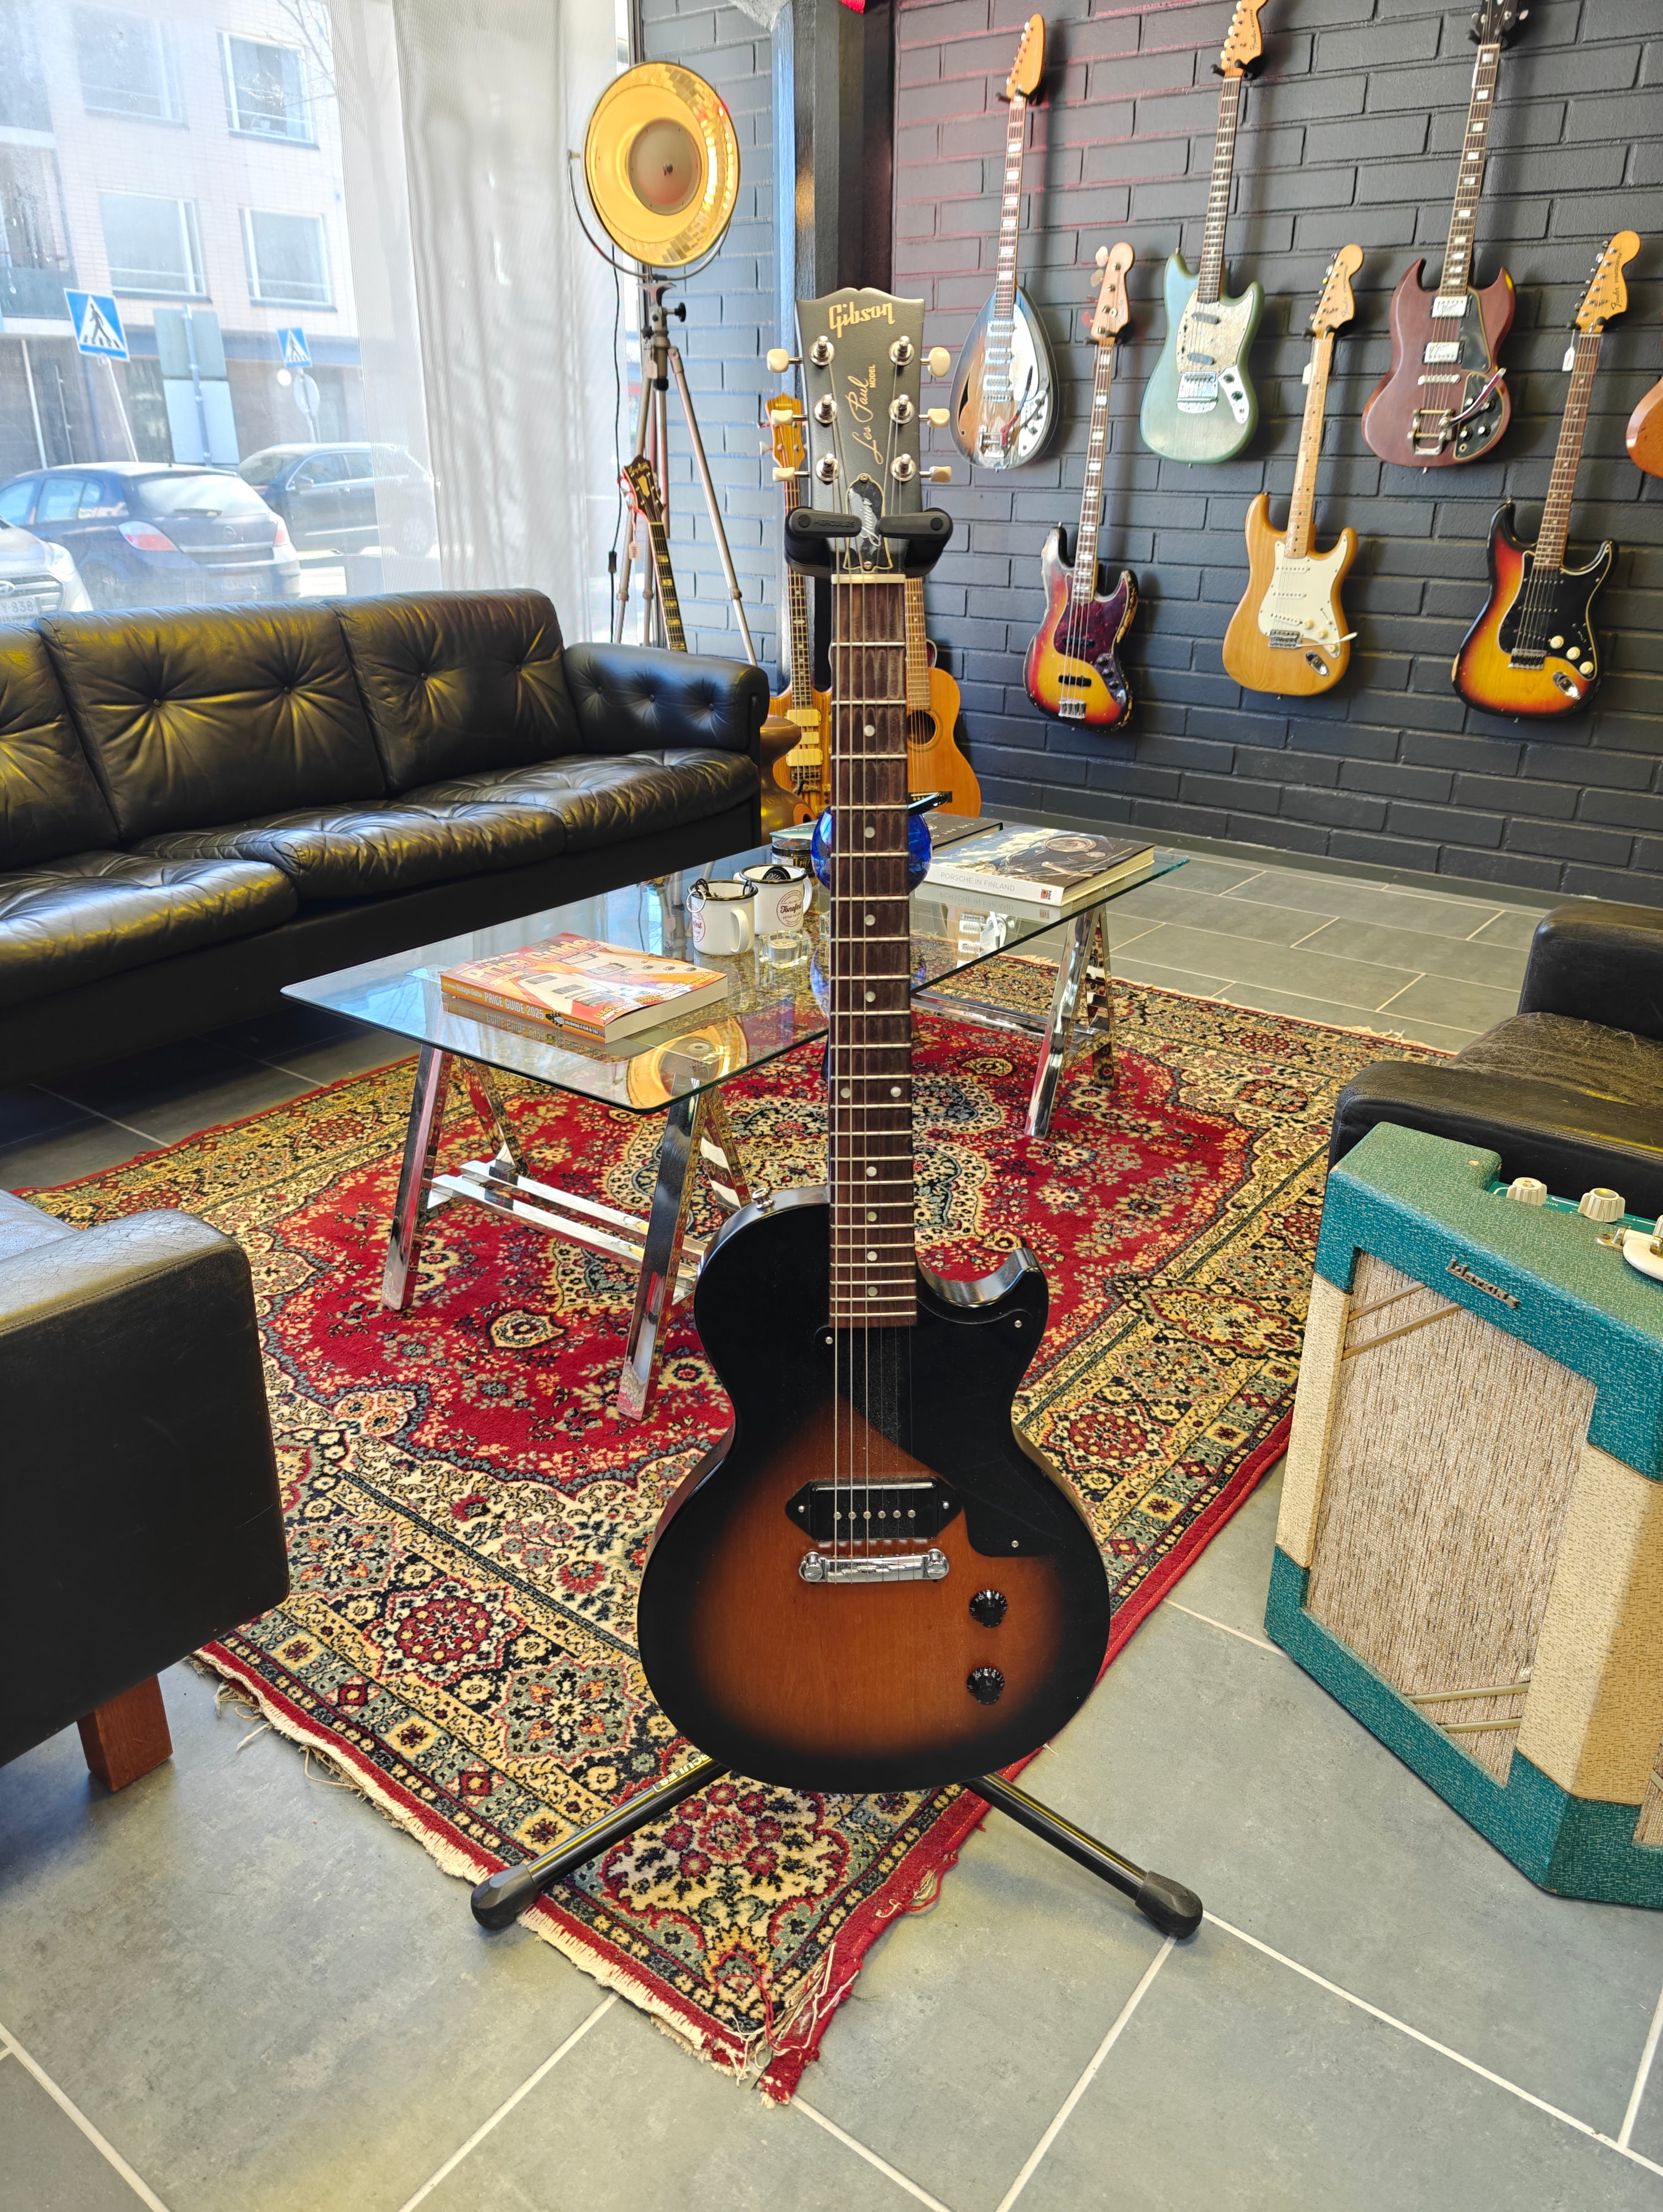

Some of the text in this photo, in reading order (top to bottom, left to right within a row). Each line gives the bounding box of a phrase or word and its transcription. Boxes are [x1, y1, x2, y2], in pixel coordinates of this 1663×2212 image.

[1611, 253, 1623, 310] Fender STRATOCASTER
[829, 301, 896, 338] Gibson
[868, 364, 877, 388] MODEL
[846, 375, 883, 465] Les Paul
[813, 519, 855, 528] HERCULES
[859, 498, 882, 547] Junior
[940, 872, 973, 884] PORSCHE
[984, 880, 1016, 891] FINLAND
[459, 959, 537, 984] Price
[525, 939, 600, 963] Guide
[484, 992, 504, 1008] PRICE
[505, 998, 525, 1014] GUIDE
[526, 1004, 545, 1020] 2025
[659, 1753, 710, 1787] RCULES
